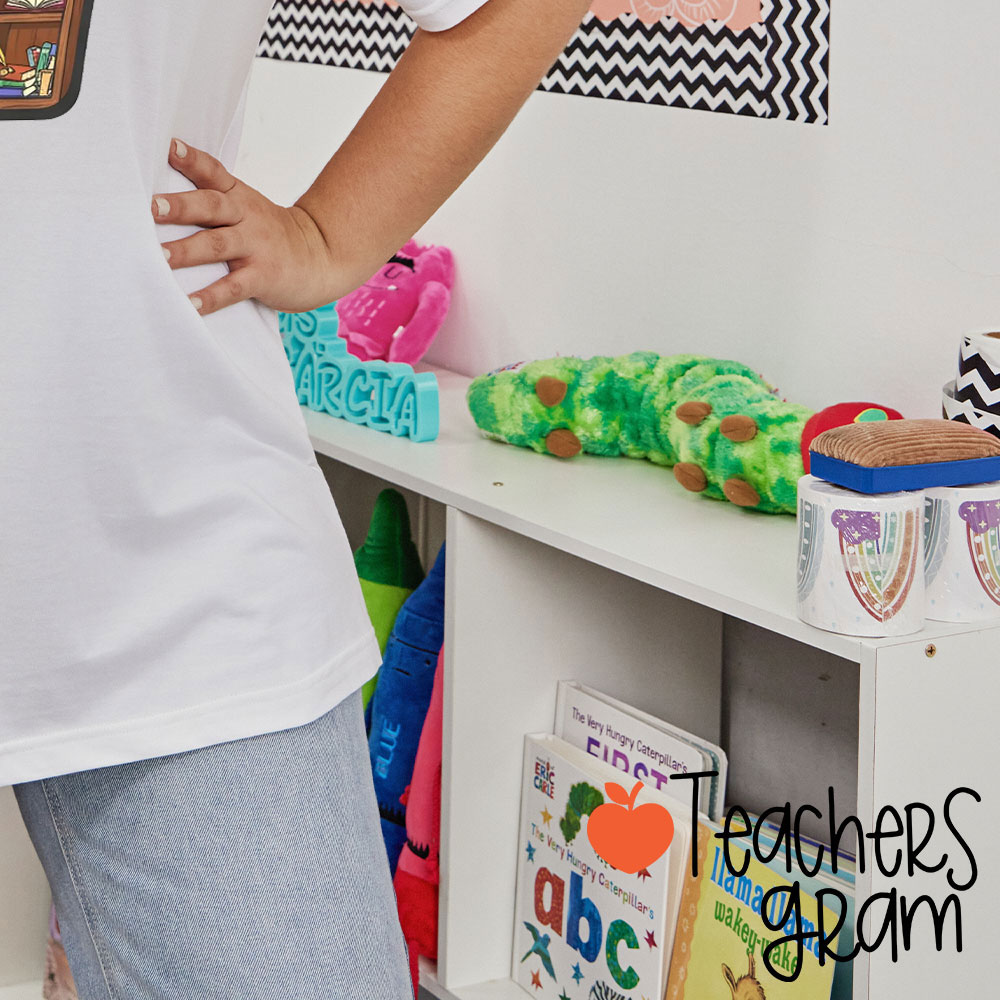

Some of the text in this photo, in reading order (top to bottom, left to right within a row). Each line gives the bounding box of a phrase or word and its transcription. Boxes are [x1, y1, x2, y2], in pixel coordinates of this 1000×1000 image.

[376, 716, 401, 779] BLUE
[534, 761, 556, 786] ERIC
[572, 706, 688, 775] The Very Hungry Caterpillar's
[533, 775, 555, 800] CARLE
[531, 822, 655, 921] The Very Hungry Caterpillar's
[533, 866, 640, 991] abc
